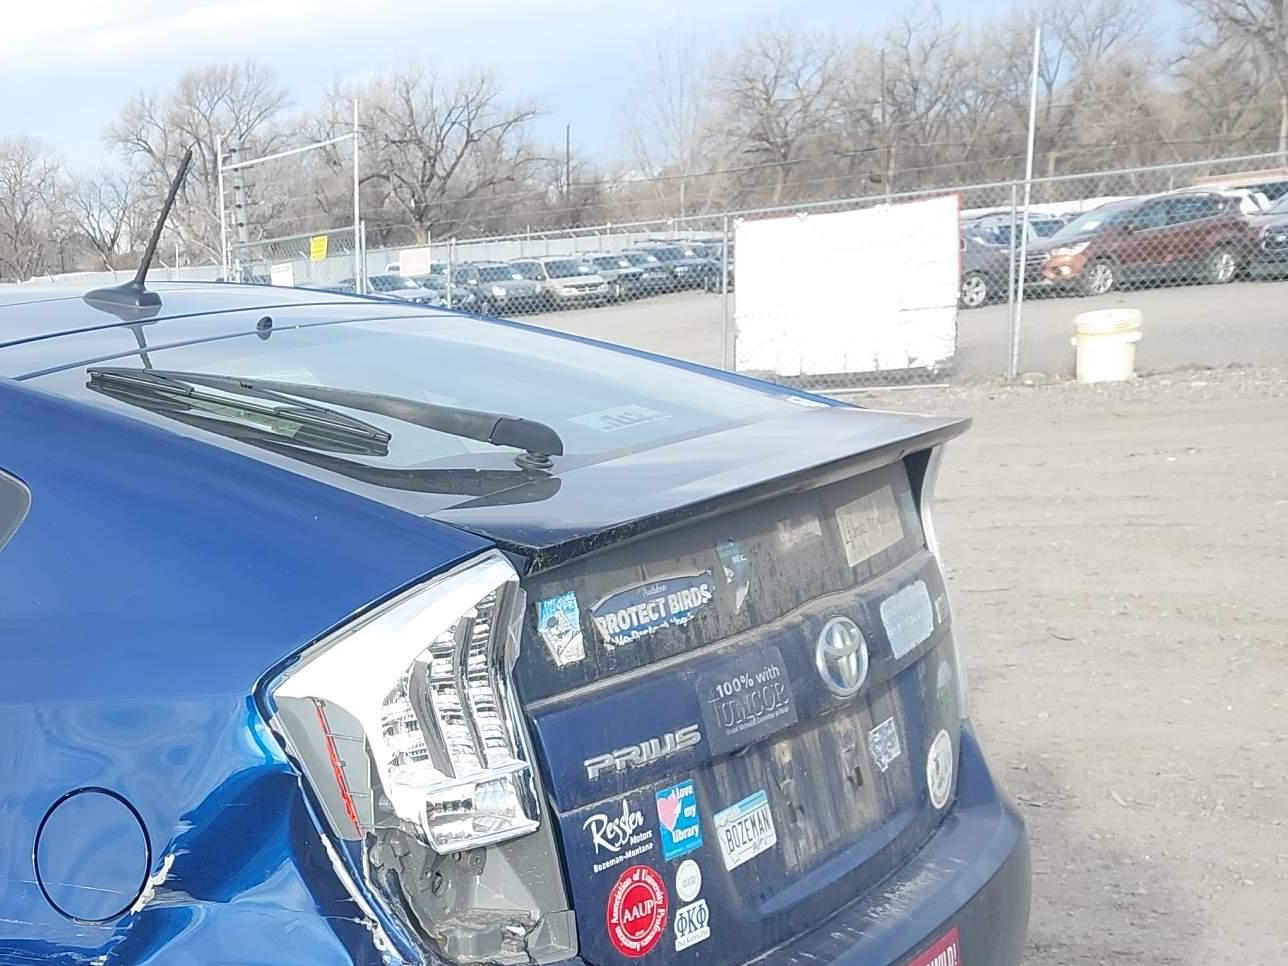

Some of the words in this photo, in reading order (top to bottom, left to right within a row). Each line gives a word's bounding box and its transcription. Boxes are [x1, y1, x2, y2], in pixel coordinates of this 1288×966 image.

[667, 583, 713, 615] BIRDS
[715, 672, 754, 698] 100%
[755, 664, 781, 684] with
[583, 723, 702, 781] PRIUS
[676, 785, 694, 799] love
[683, 804, 696, 818] my
[583, 798, 644, 855] Ressler
[630, 830, 653, 846] Motors
[672, 823, 699, 844] library
[725, 807, 772, 854] BOZEMAN
[623, 899, 654, 924] AAUP
